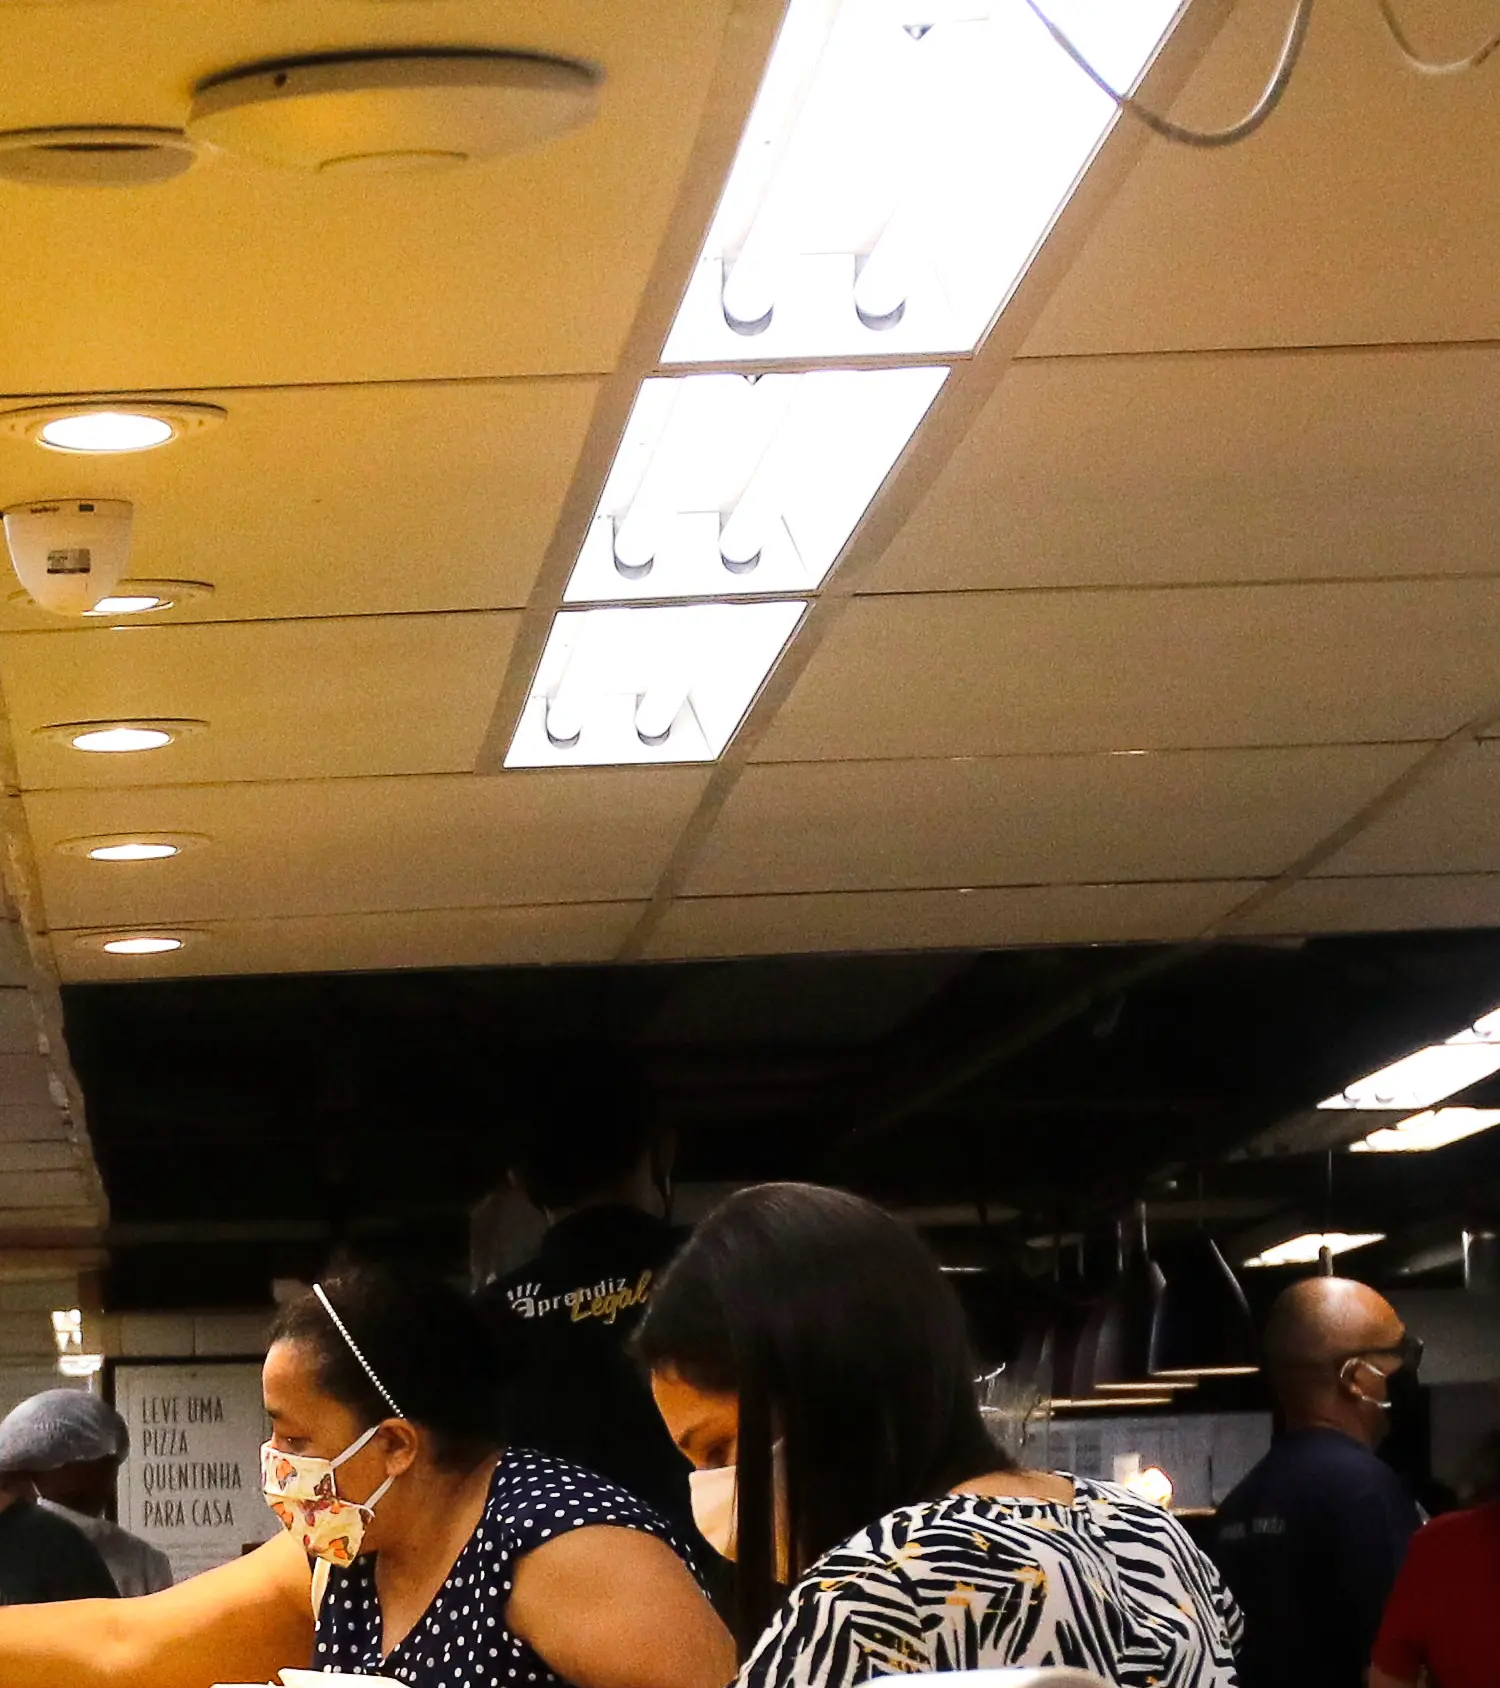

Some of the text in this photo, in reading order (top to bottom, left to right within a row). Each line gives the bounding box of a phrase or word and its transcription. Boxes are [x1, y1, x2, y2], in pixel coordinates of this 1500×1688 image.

[571, 1269, 652, 1324] Legal
[142, 1394, 224, 1424] LEVE UMA
[143, 1428, 190, 1456] PIZZA
[143, 1461, 242, 1496] QUENTINHA
[144, 1497, 235, 1528] PARA CASA
